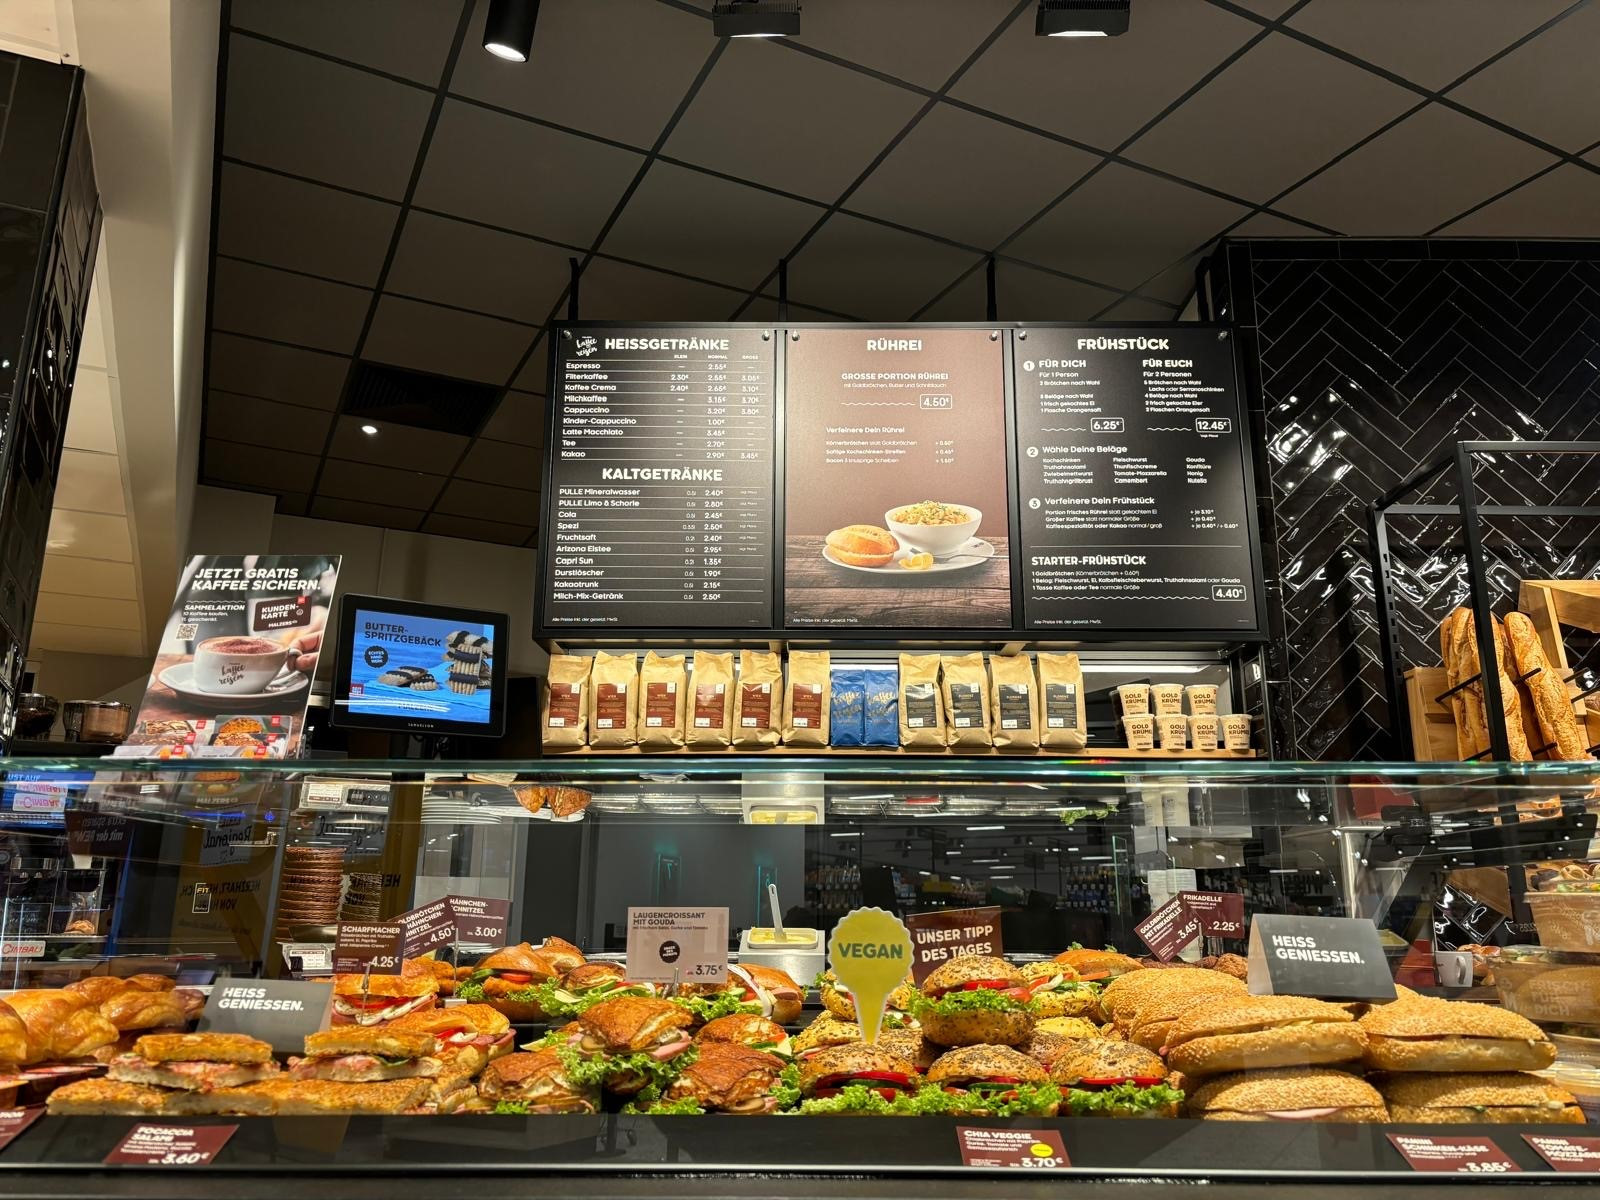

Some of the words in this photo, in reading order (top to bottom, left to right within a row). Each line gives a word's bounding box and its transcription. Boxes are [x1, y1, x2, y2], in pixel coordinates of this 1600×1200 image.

[605, 337, 729, 350] HEISSGETRÄNKE
[867, 338, 922, 351] RÜHREI
[1078, 337, 1170, 350] FRÜHSTÜCK
[1039, 359, 1059, 368] FÜR
[1061, 360, 1086, 368] DICH
[1143, 358, 1163, 368] FÜR
[1165, 360, 1193, 368] EUCH
[918, 372, 948, 380] RÜHREI
[924, 397, 949, 407] 4.50€
[1097, 446, 1128, 454] Beläge
[602, 467, 723, 480] KALTGETRÄNKE
[1113, 497, 1155, 505] Frühstück
[558, 522, 579, 530] Spezi
[556, 557, 578, 565] Capri
[1032, 555, 1146, 565] STARTER-FRÜHSTÜCK
[195, 568, 243, 579] JETZT
[246, 568, 299, 579] GRATIS
[192, 580, 250, 590] KAFFEE
[252, 580, 321, 590] SICHERN.
[554, 592, 624, 600] Milch-Mix-Getränk
[1216, 588, 1243, 598] 4.40€
[262, 604, 299, 613] KUNDEN-
[261, 612, 288, 620] KARTE
[366, 622, 408, 633] BUTTER-
[365, 631, 442, 647] SPRITZGEBÄCK
[342, 926, 400, 934] SCHARFMACHER
[917, 929, 960, 944] UNSER
[964, 925, 993, 939] TIPP
[1272, 935, 1316, 948] HEISS
[2, 944, 42, 954] CIMBALI
[838, 943, 903, 958] VEGAN
[922, 948, 947, 962] DES
[951, 942, 992, 958] TAGES
[1276, 948, 1365, 964] GENIESSEN.
[222, 988, 267, 998] HEISS
[218, 998, 304, 1011] GENIESSEN.
[138, 1127, 194, 1136] FOCACCIA
[964, 1130, 991, 1138] CHIA
[992, 1132, 1033, 1140] VEGGIE
